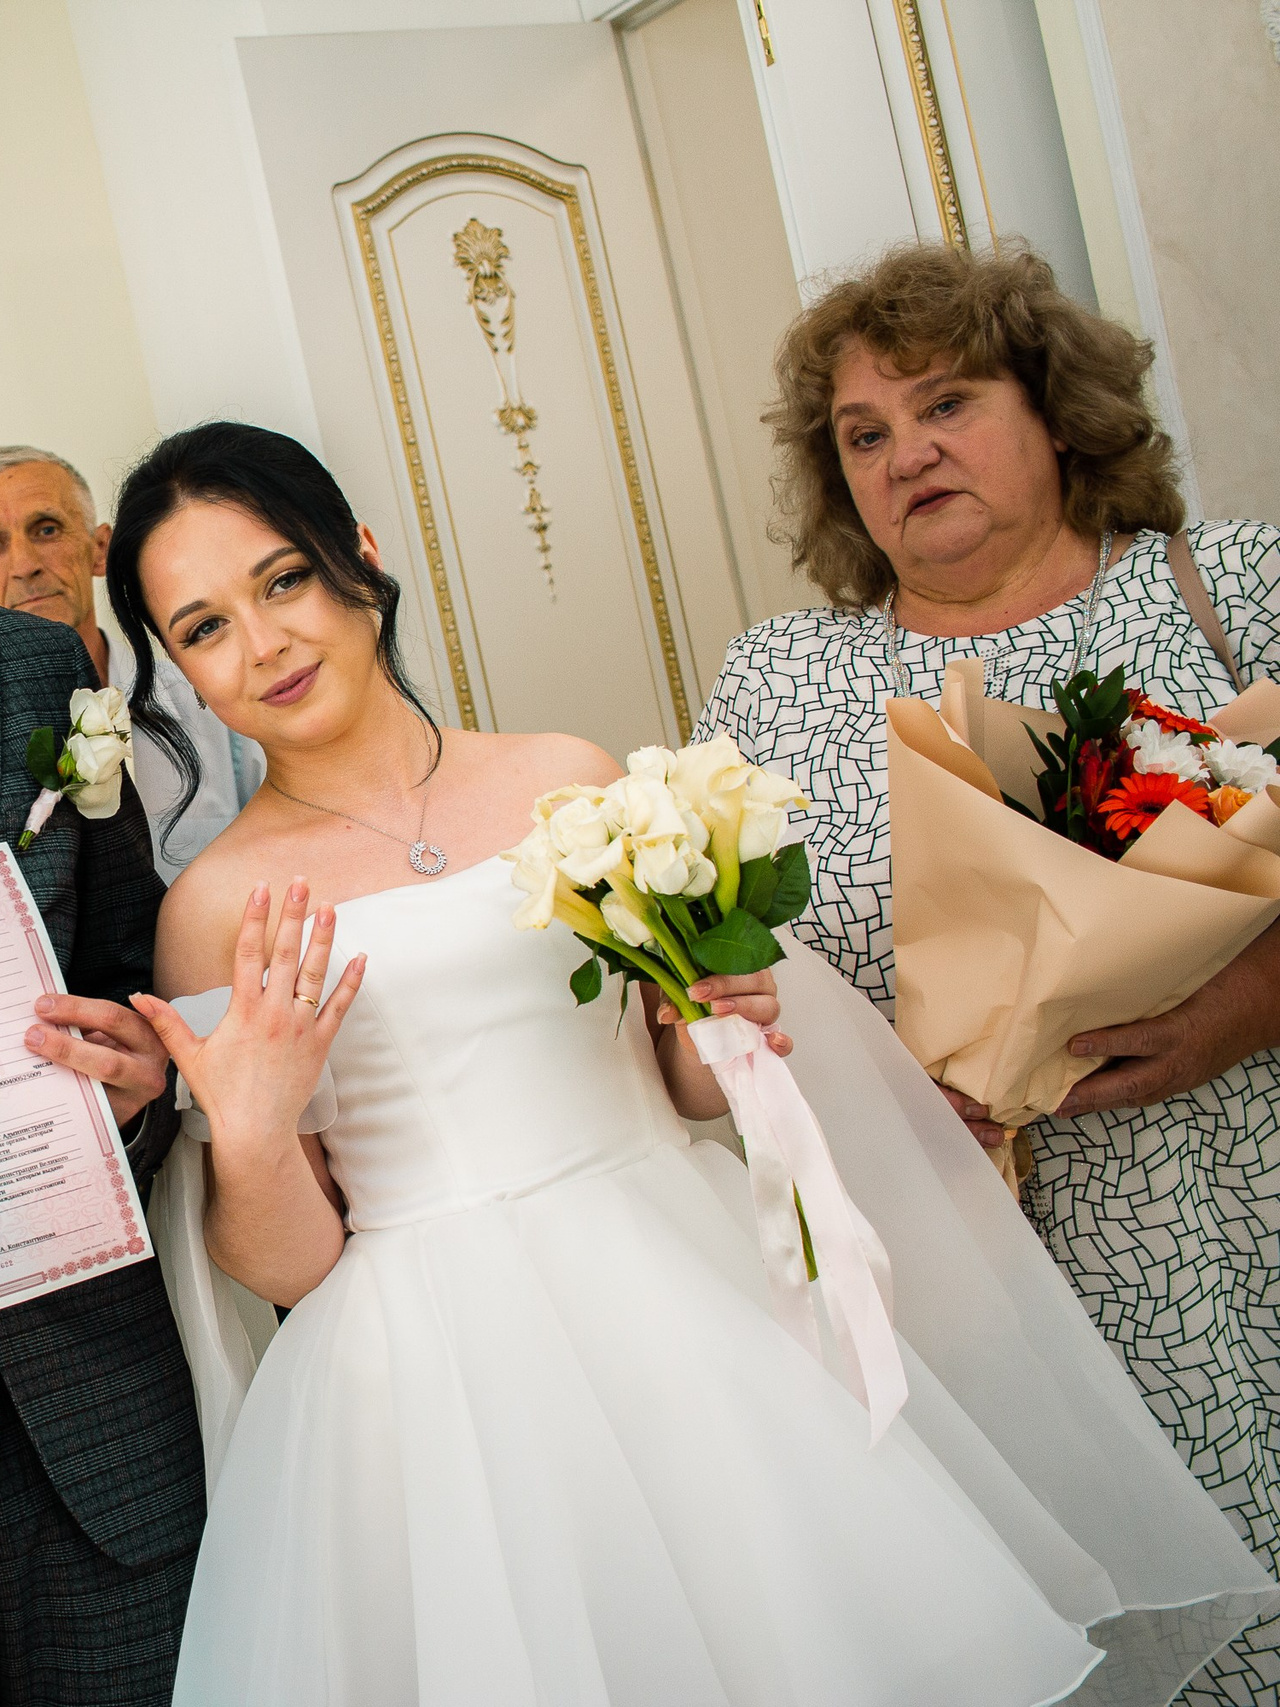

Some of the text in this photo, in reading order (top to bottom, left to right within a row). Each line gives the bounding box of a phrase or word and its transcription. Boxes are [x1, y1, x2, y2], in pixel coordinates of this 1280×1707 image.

[32, 1060, 52, 1069] числа
[2, 1120, 53, 1138] Администрации
[27, 1128, 52, 1138] которым
[18, 1144, 49, 1156] состояния)
[38, 1155, 68, 1167] Великого
[15, 1171, 40, 1181] которым
[42, 1164, 63, 1174] выдано
[34, 1178, 65, 1191] состояния)
[7, 1232, 55, 1249] Константинова
